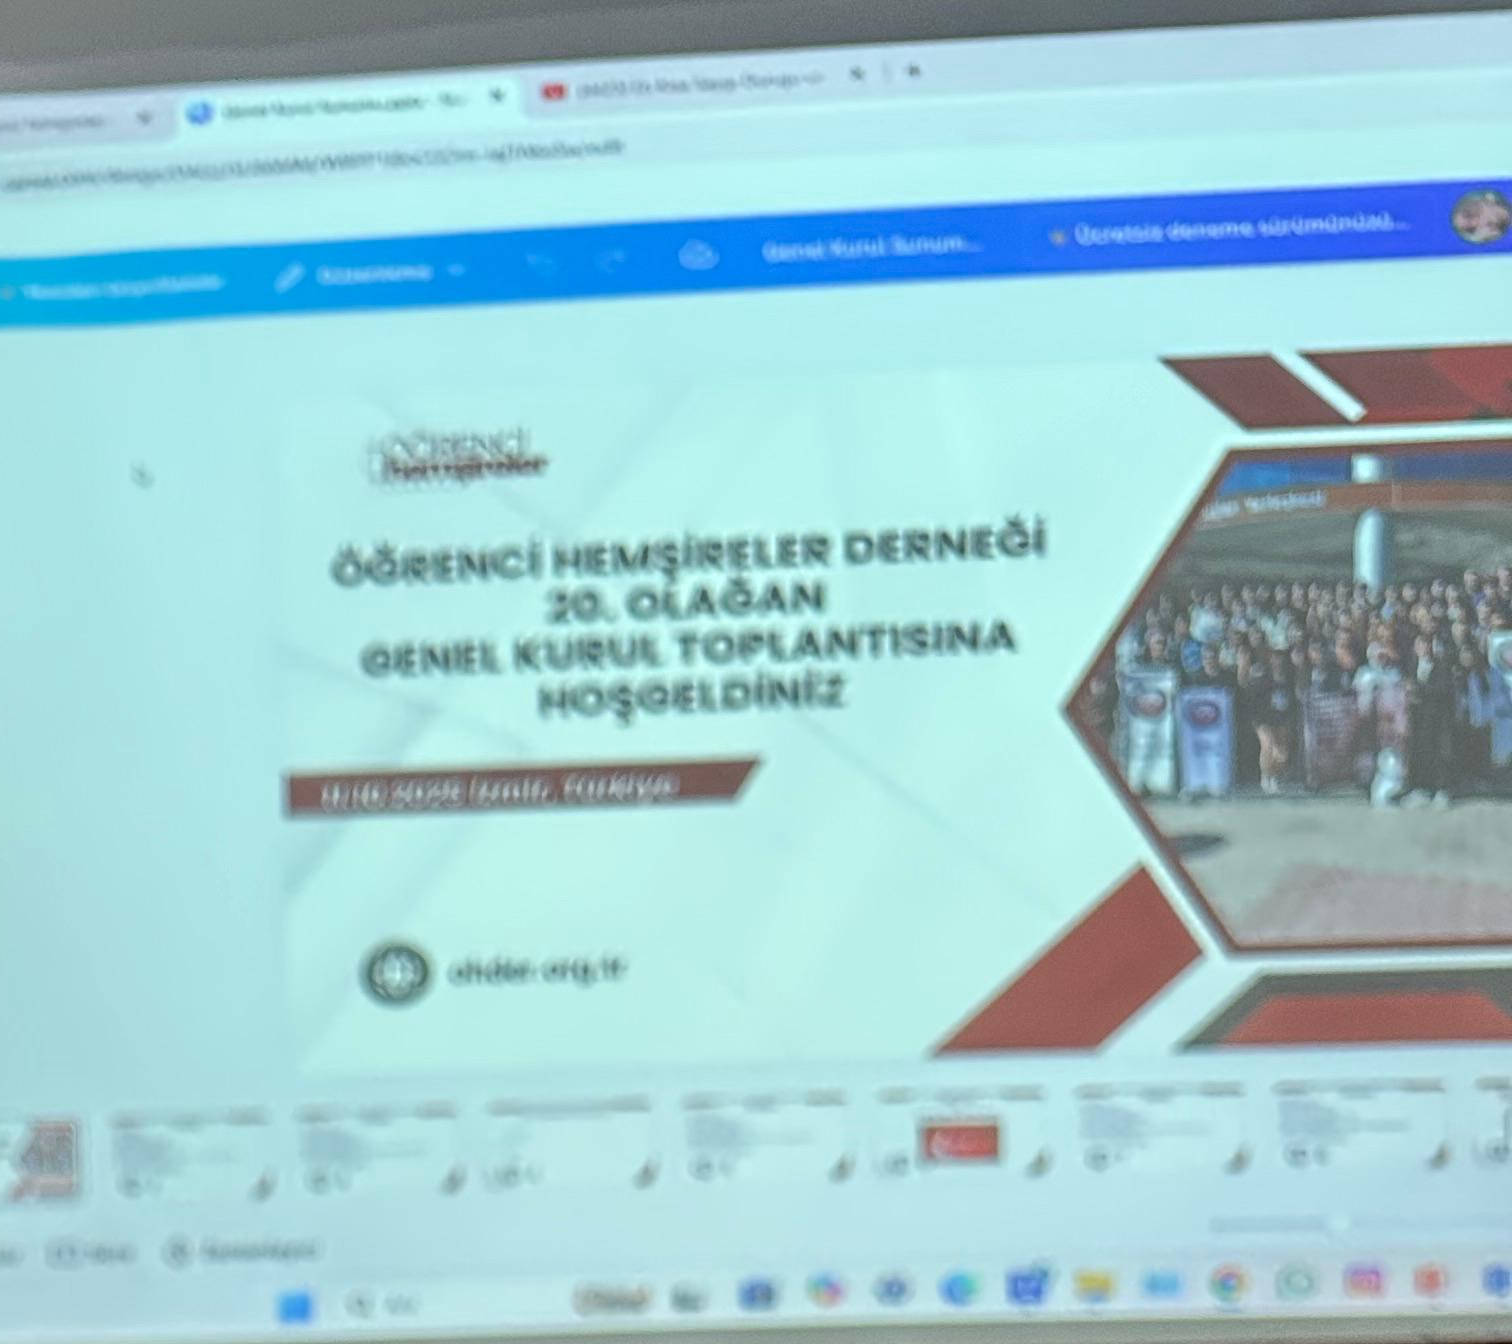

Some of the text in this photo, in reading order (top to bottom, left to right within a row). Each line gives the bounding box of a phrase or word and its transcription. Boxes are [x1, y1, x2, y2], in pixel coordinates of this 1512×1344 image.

[331, 514, 1048, 587] ÖĞRENCİ HEMŞİRELER DERNEĞİ
[544, 577, 825, 625] 20. OLAĞAN
[360, 619, 1018, 678] GENEL KURUL TOPLANTISINA
[536, 669, 846, 727] HOŞGELDİNİZ
